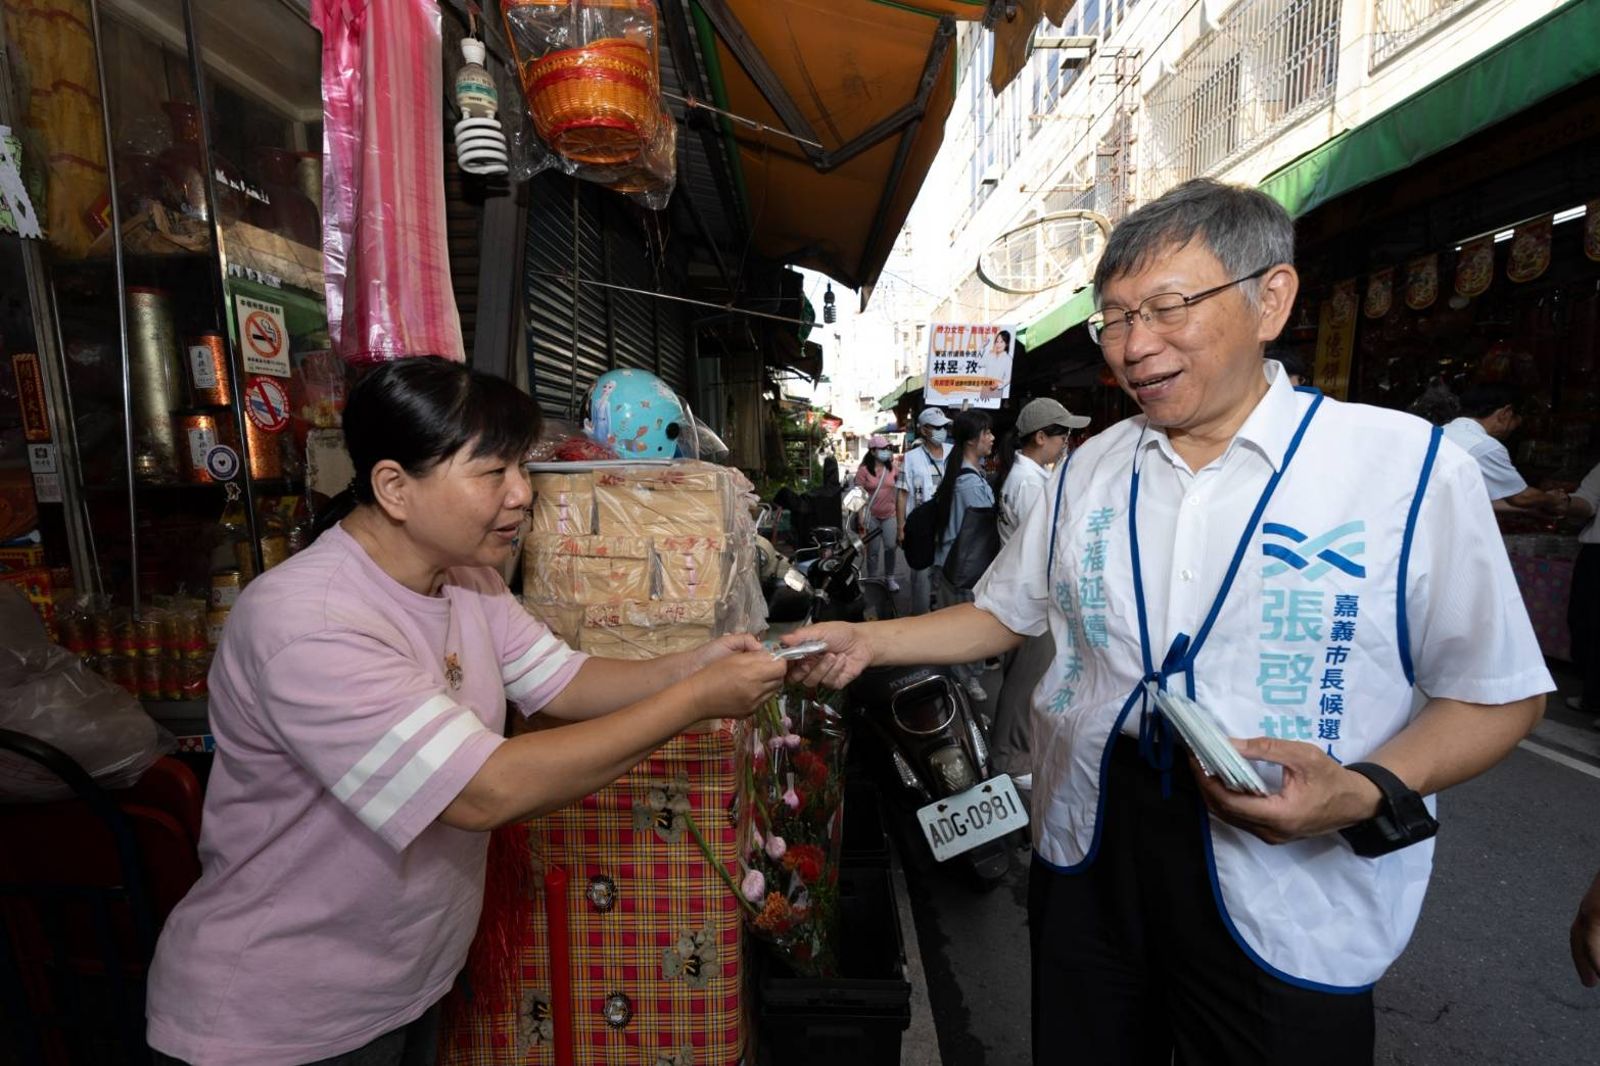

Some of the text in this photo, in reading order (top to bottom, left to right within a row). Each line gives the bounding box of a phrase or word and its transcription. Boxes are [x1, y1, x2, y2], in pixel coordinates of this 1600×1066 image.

[1080, 506, 1115, 649] 幸福延續
[888, 669, 930, 688] KYMCO
[1318, 594, 1360, 765] 嘉義市長候選人
